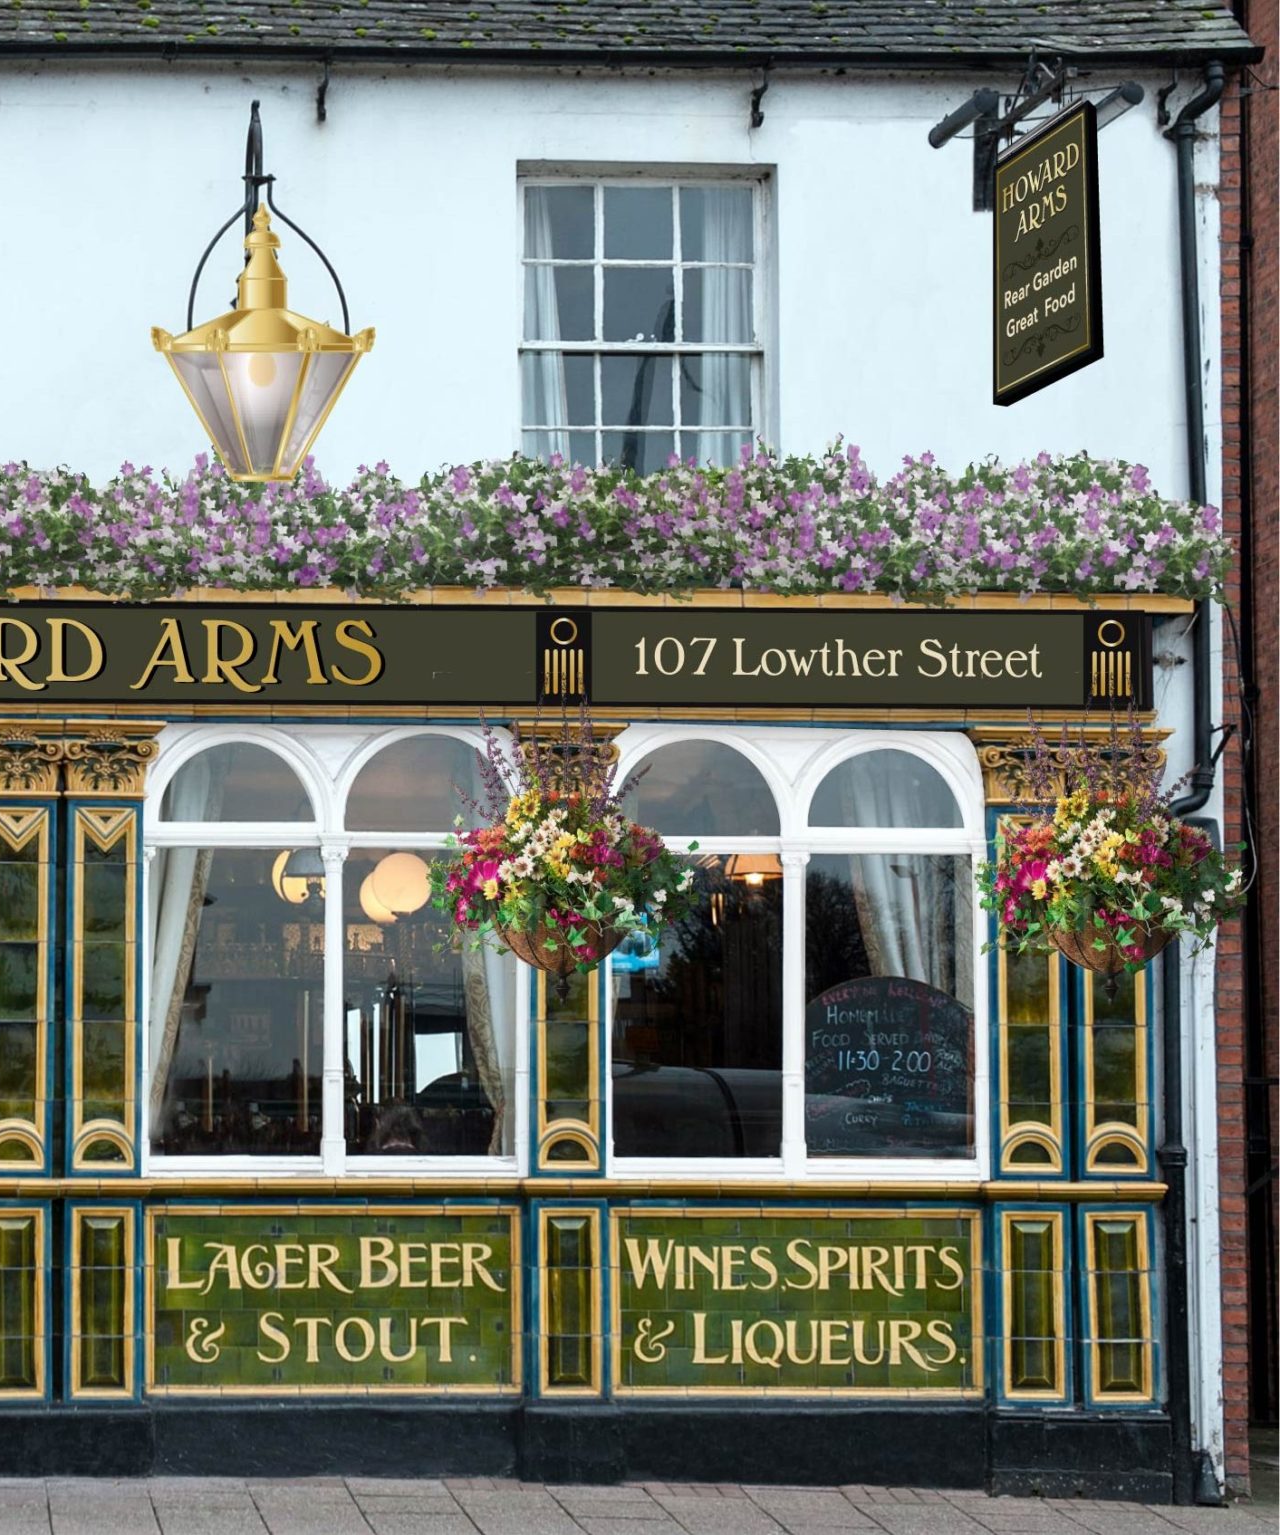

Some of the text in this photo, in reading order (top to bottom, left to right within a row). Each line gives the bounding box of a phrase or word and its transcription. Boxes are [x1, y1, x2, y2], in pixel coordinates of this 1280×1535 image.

[1002, 142, 1080, 213] HOWARD
[1014, 184, 1068, 242] ARMS
[1004, 255, 1079, 310] Rear Garden
[1005, 282, 1077, 339] Great Food
[130, 618, 381, 692] ARMS
[635, 637, 1042, 677] 107 Lowther Street
[167, 1237, 504, 1294] LAGER BEER
[186, 1312, 475, 1362] & STOUT.
[635, 1319, 674, 1362] &
